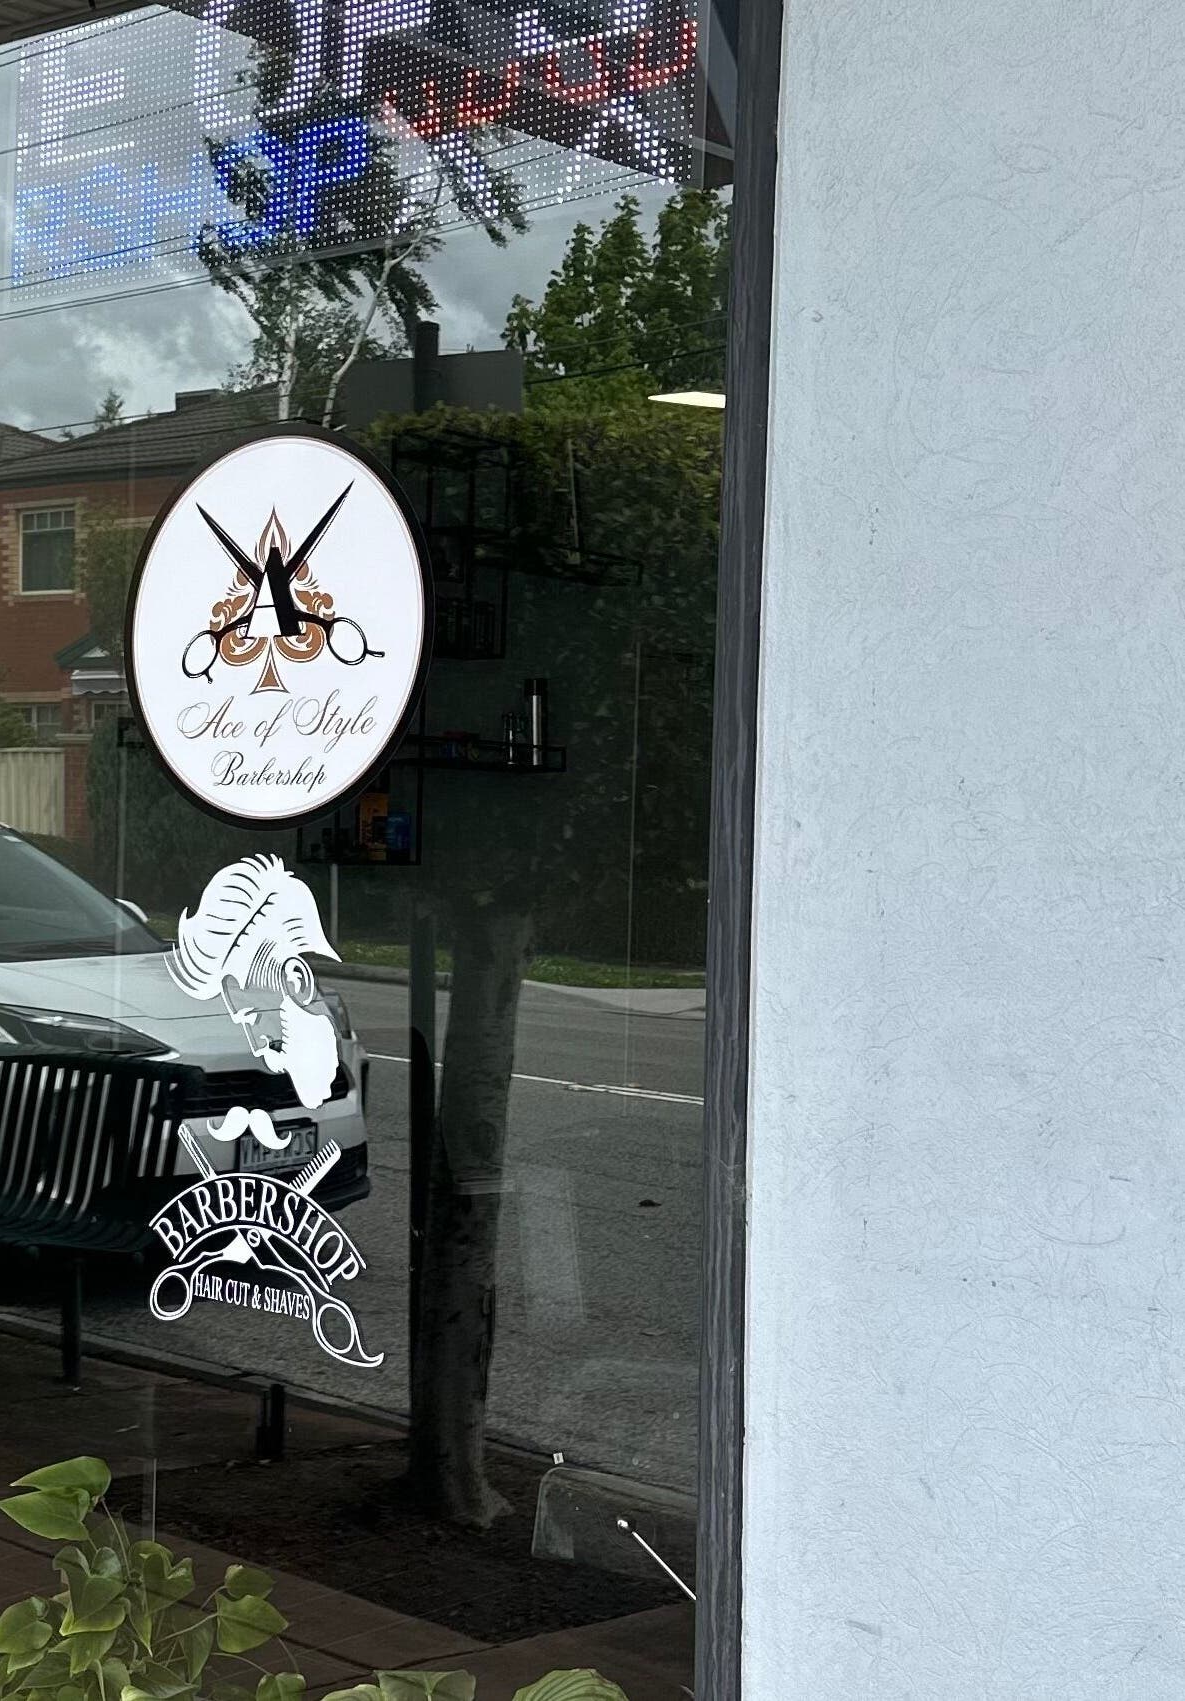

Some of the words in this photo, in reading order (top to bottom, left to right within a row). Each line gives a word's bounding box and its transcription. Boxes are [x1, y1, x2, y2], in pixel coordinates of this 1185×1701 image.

[176, 695, 247, 740] Ace
[253, 698, 293, 748] of
[292, 688, 379, 753] Style
[210, 750, 328, 793] Barbershop
[153, 1178, 360, 1286] BARBERSHOP
[193, 1273, 222, 1302] HAIR
[225, 1278, 251, 1307] CUT
[251, 1288, 261, 1310] &
[263, 1286, 310, 1320] SHAVES
